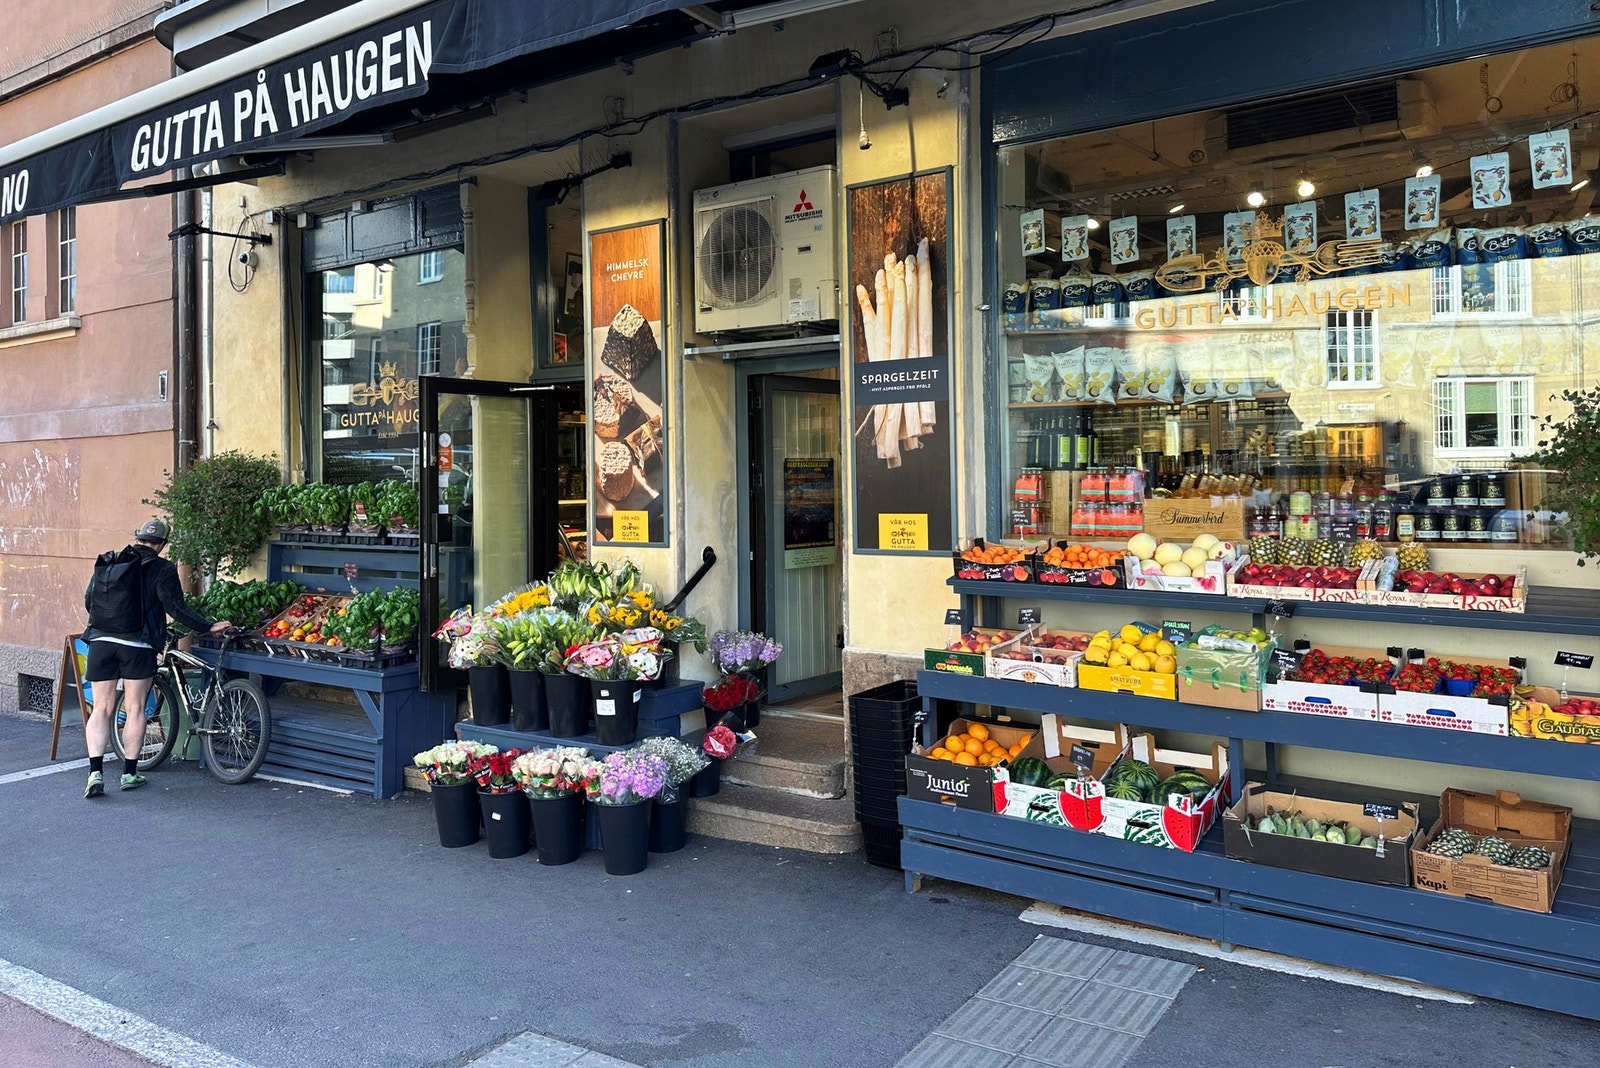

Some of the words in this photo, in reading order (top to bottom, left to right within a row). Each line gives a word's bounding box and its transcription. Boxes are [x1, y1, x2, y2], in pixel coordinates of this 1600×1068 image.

[131, 99, 225, 173] GUTTA
[233, 68, 279, 143] PÅ
[283, 20, 433, 128] HAUGEN
[1, 169, 29, 217] NO
[784, 209, 823, 220] MITSUBISHI
[606, 258, 649, 271] HIMMELSK
[611, 270, 644, 282] CHEVRE
[1135, 301, 1238, 329] GUTTA
[1237, 296, 1258, 309] PÅ
[1261, 284, 1410, 317] HAUGEN
[1268, 331, 1294, 342] 1994
[861, 369, 939, 384] SPARGELZEIT
[340, 413, 379, 427] GUTTA
[378, 409, 387, 419] PÅ
[1160, 507, 1225, 525] Summerbird
[986, 572, 1001, 580] Fruit
[1070, 575, 1087, 583] Fruit
[1305, 588, 1364, 602] ROYAL
[1453, 595, 1520, 611] ROYAL
[926, 774, 970, 793] Junior
[1416, 875, 1449, 891] Kapi
